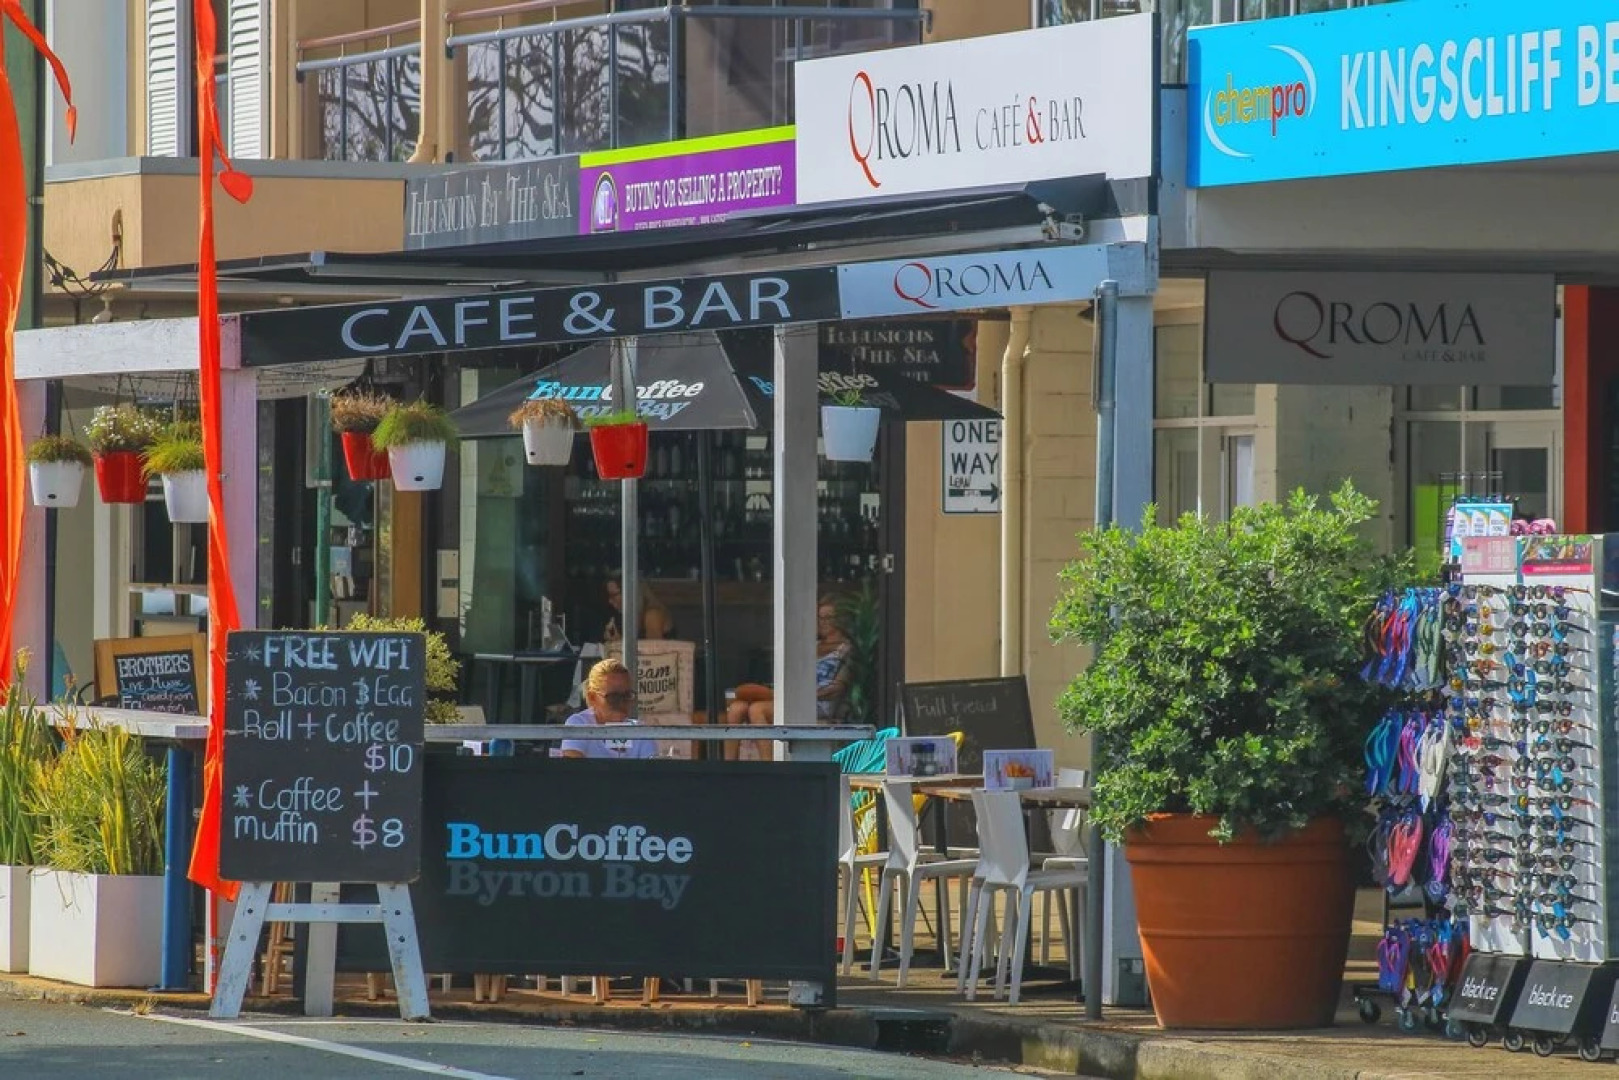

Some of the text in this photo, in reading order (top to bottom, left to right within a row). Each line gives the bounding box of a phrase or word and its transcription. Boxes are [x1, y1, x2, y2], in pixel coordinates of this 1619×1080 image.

[1341, 28, 1562, 130] KINGSCLIFF
[1215, 72, 1306, 137] chempro
[848, 70, 1087, 188] QROMA CAFÉ & BAR
[625, 165, 783, 213] BUYING OR SELLING A PROPERTY?
[893, 259, 1055, 309] QROMA
[341, 277, 792, 353] CAFE & BAR
[1274, 290, 1487, 359] QROMA
[951, 421, 998, 444] ONE
[951, 452, 999, 475] WAY
[117, 653, 191, 678] BROTHERS
[263, 635, 412, 670] FREE WIFI
[273, 671, 346, 707] Bacon
[638, 677, 676, 694] NOUGH
[243, 709, 293, 741] Roll
[325, 711, 400, 744] Coffee
[363, 742, 414, 773] $10
[258, 777, 344, 812] Coffee
[446, 822, 694, 864] BunCoffee
[445, 860, 692, 911] Byron Bay
